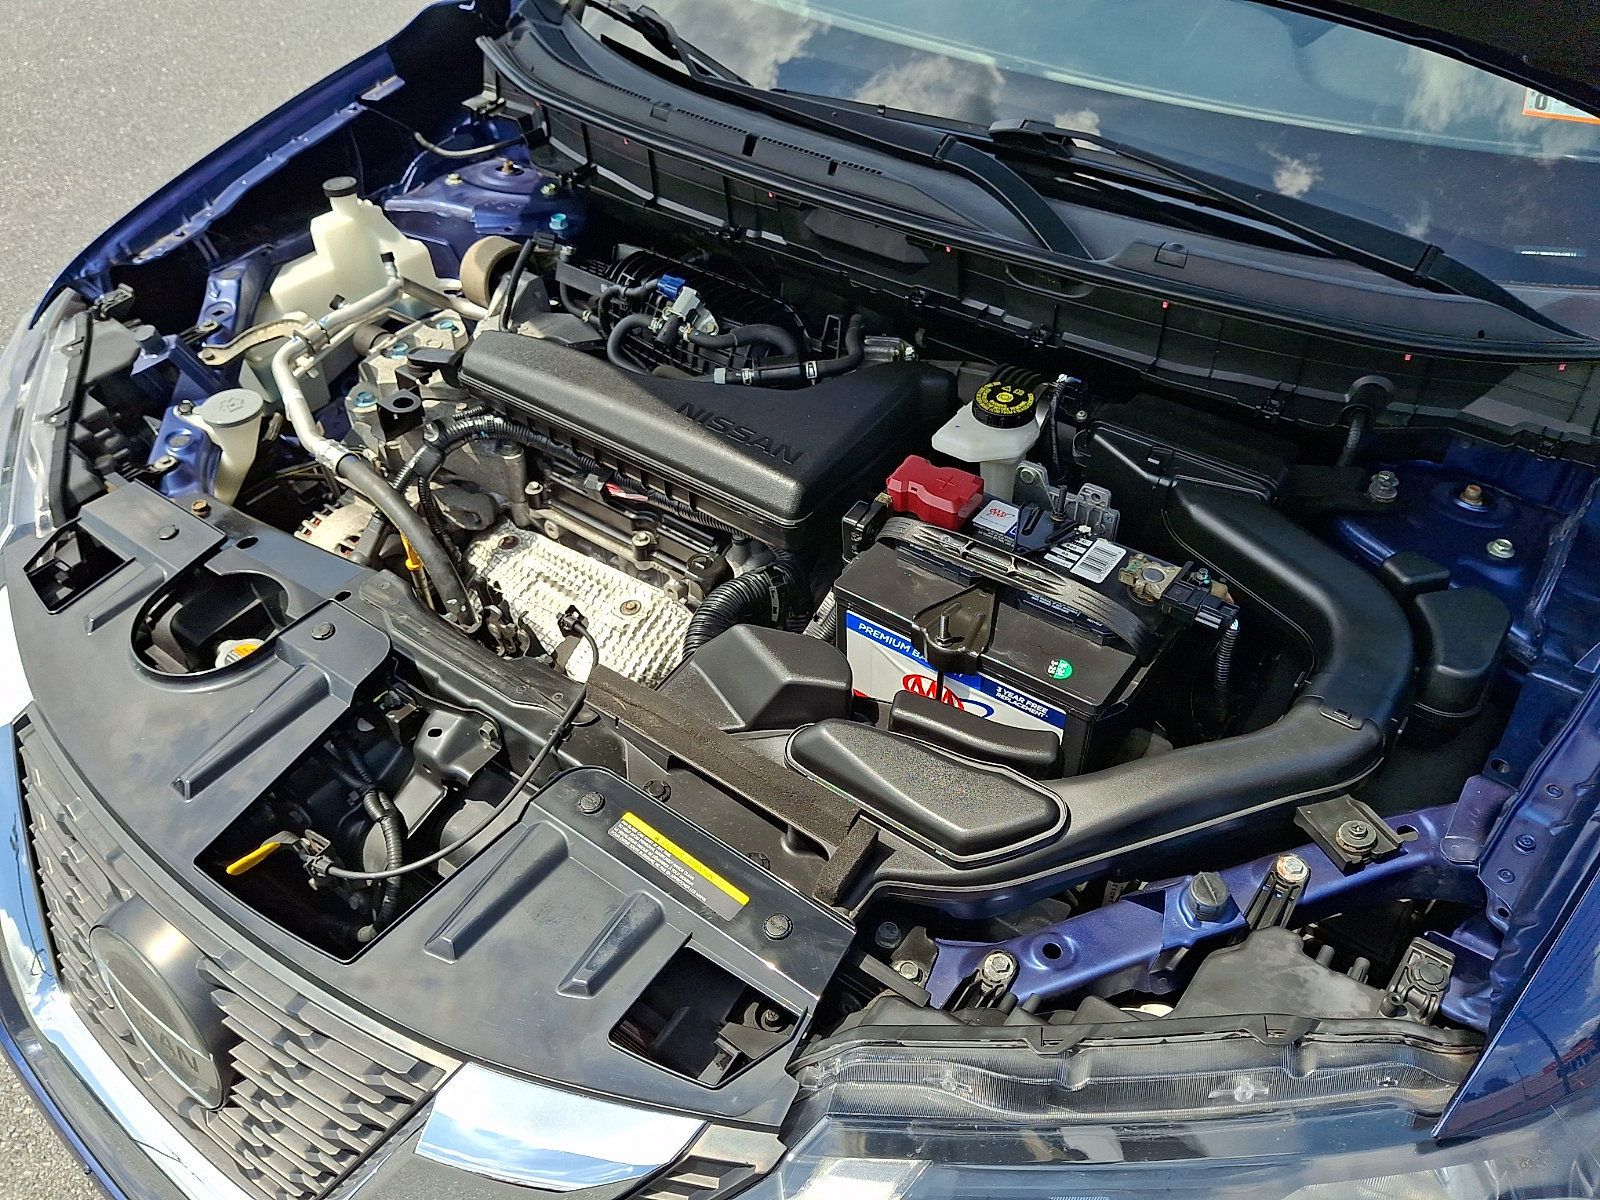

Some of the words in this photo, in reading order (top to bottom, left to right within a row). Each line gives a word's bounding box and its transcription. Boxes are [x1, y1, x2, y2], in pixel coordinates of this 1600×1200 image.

[673, 401, 806, 466] NISSAN
[858, 622, 911, 653] PREMIUM
[1003, 689, 1026, 703] YEAR
[1026, 700, 1048, 714] FREE
